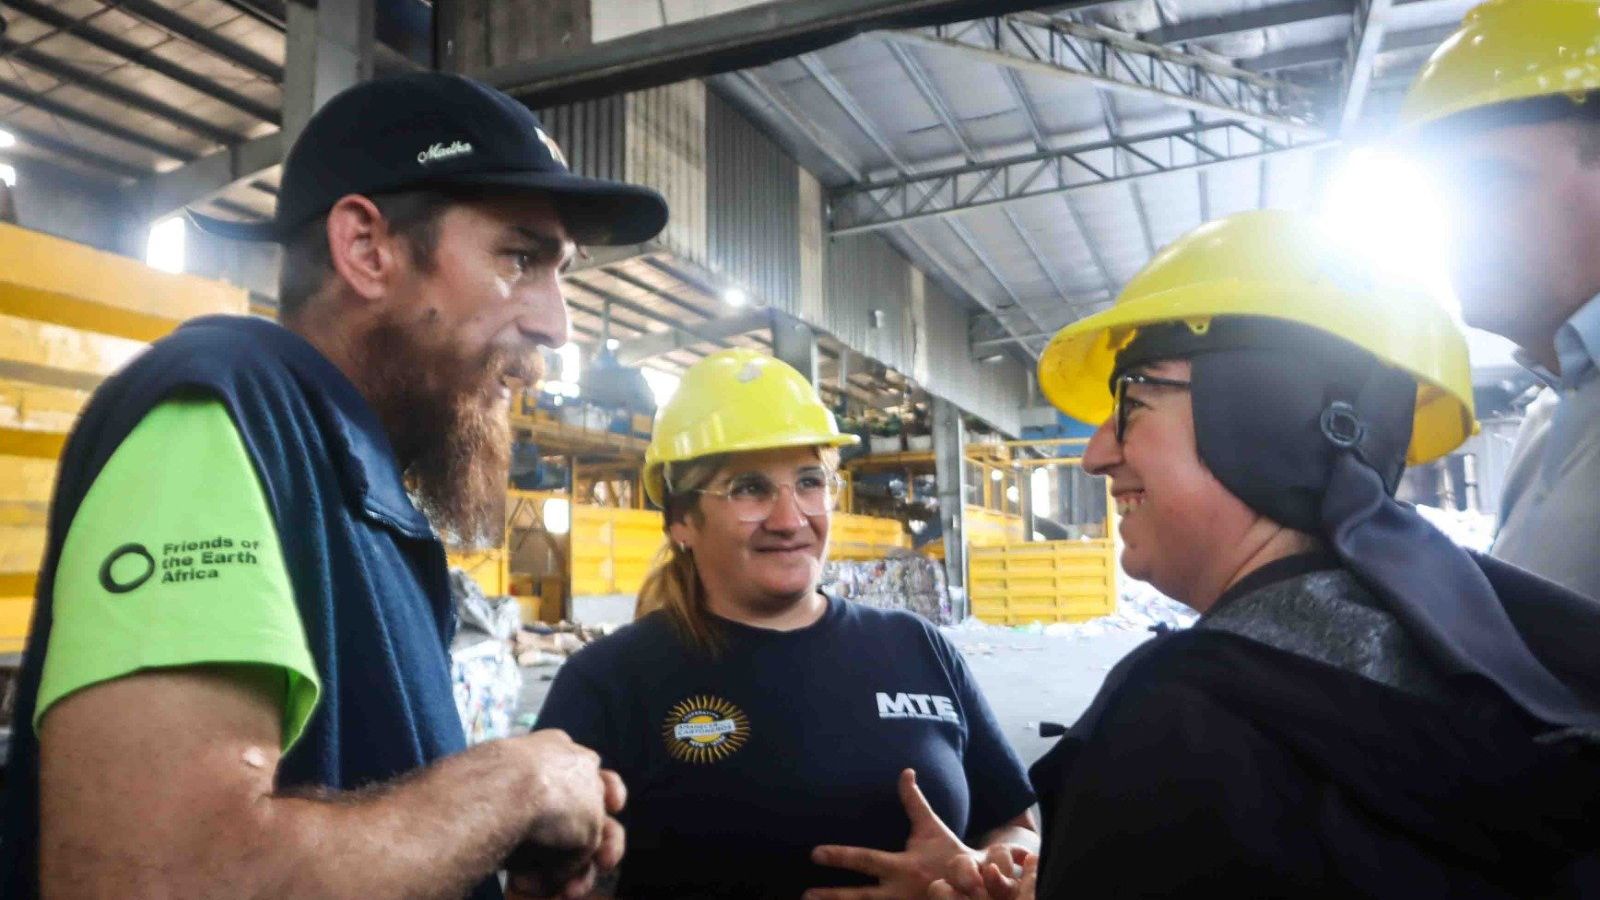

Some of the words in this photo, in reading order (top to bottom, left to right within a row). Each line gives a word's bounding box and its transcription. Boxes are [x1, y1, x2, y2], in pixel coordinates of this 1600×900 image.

[163, 535, 234, 555] Friends
[240, 540, 259, 550] of
[162, 555, 194, 570] the
[201, 551, 257, 565] Earth
[162, 568, 219, 583] Africa
[876, 692, 957, 717] MTE
